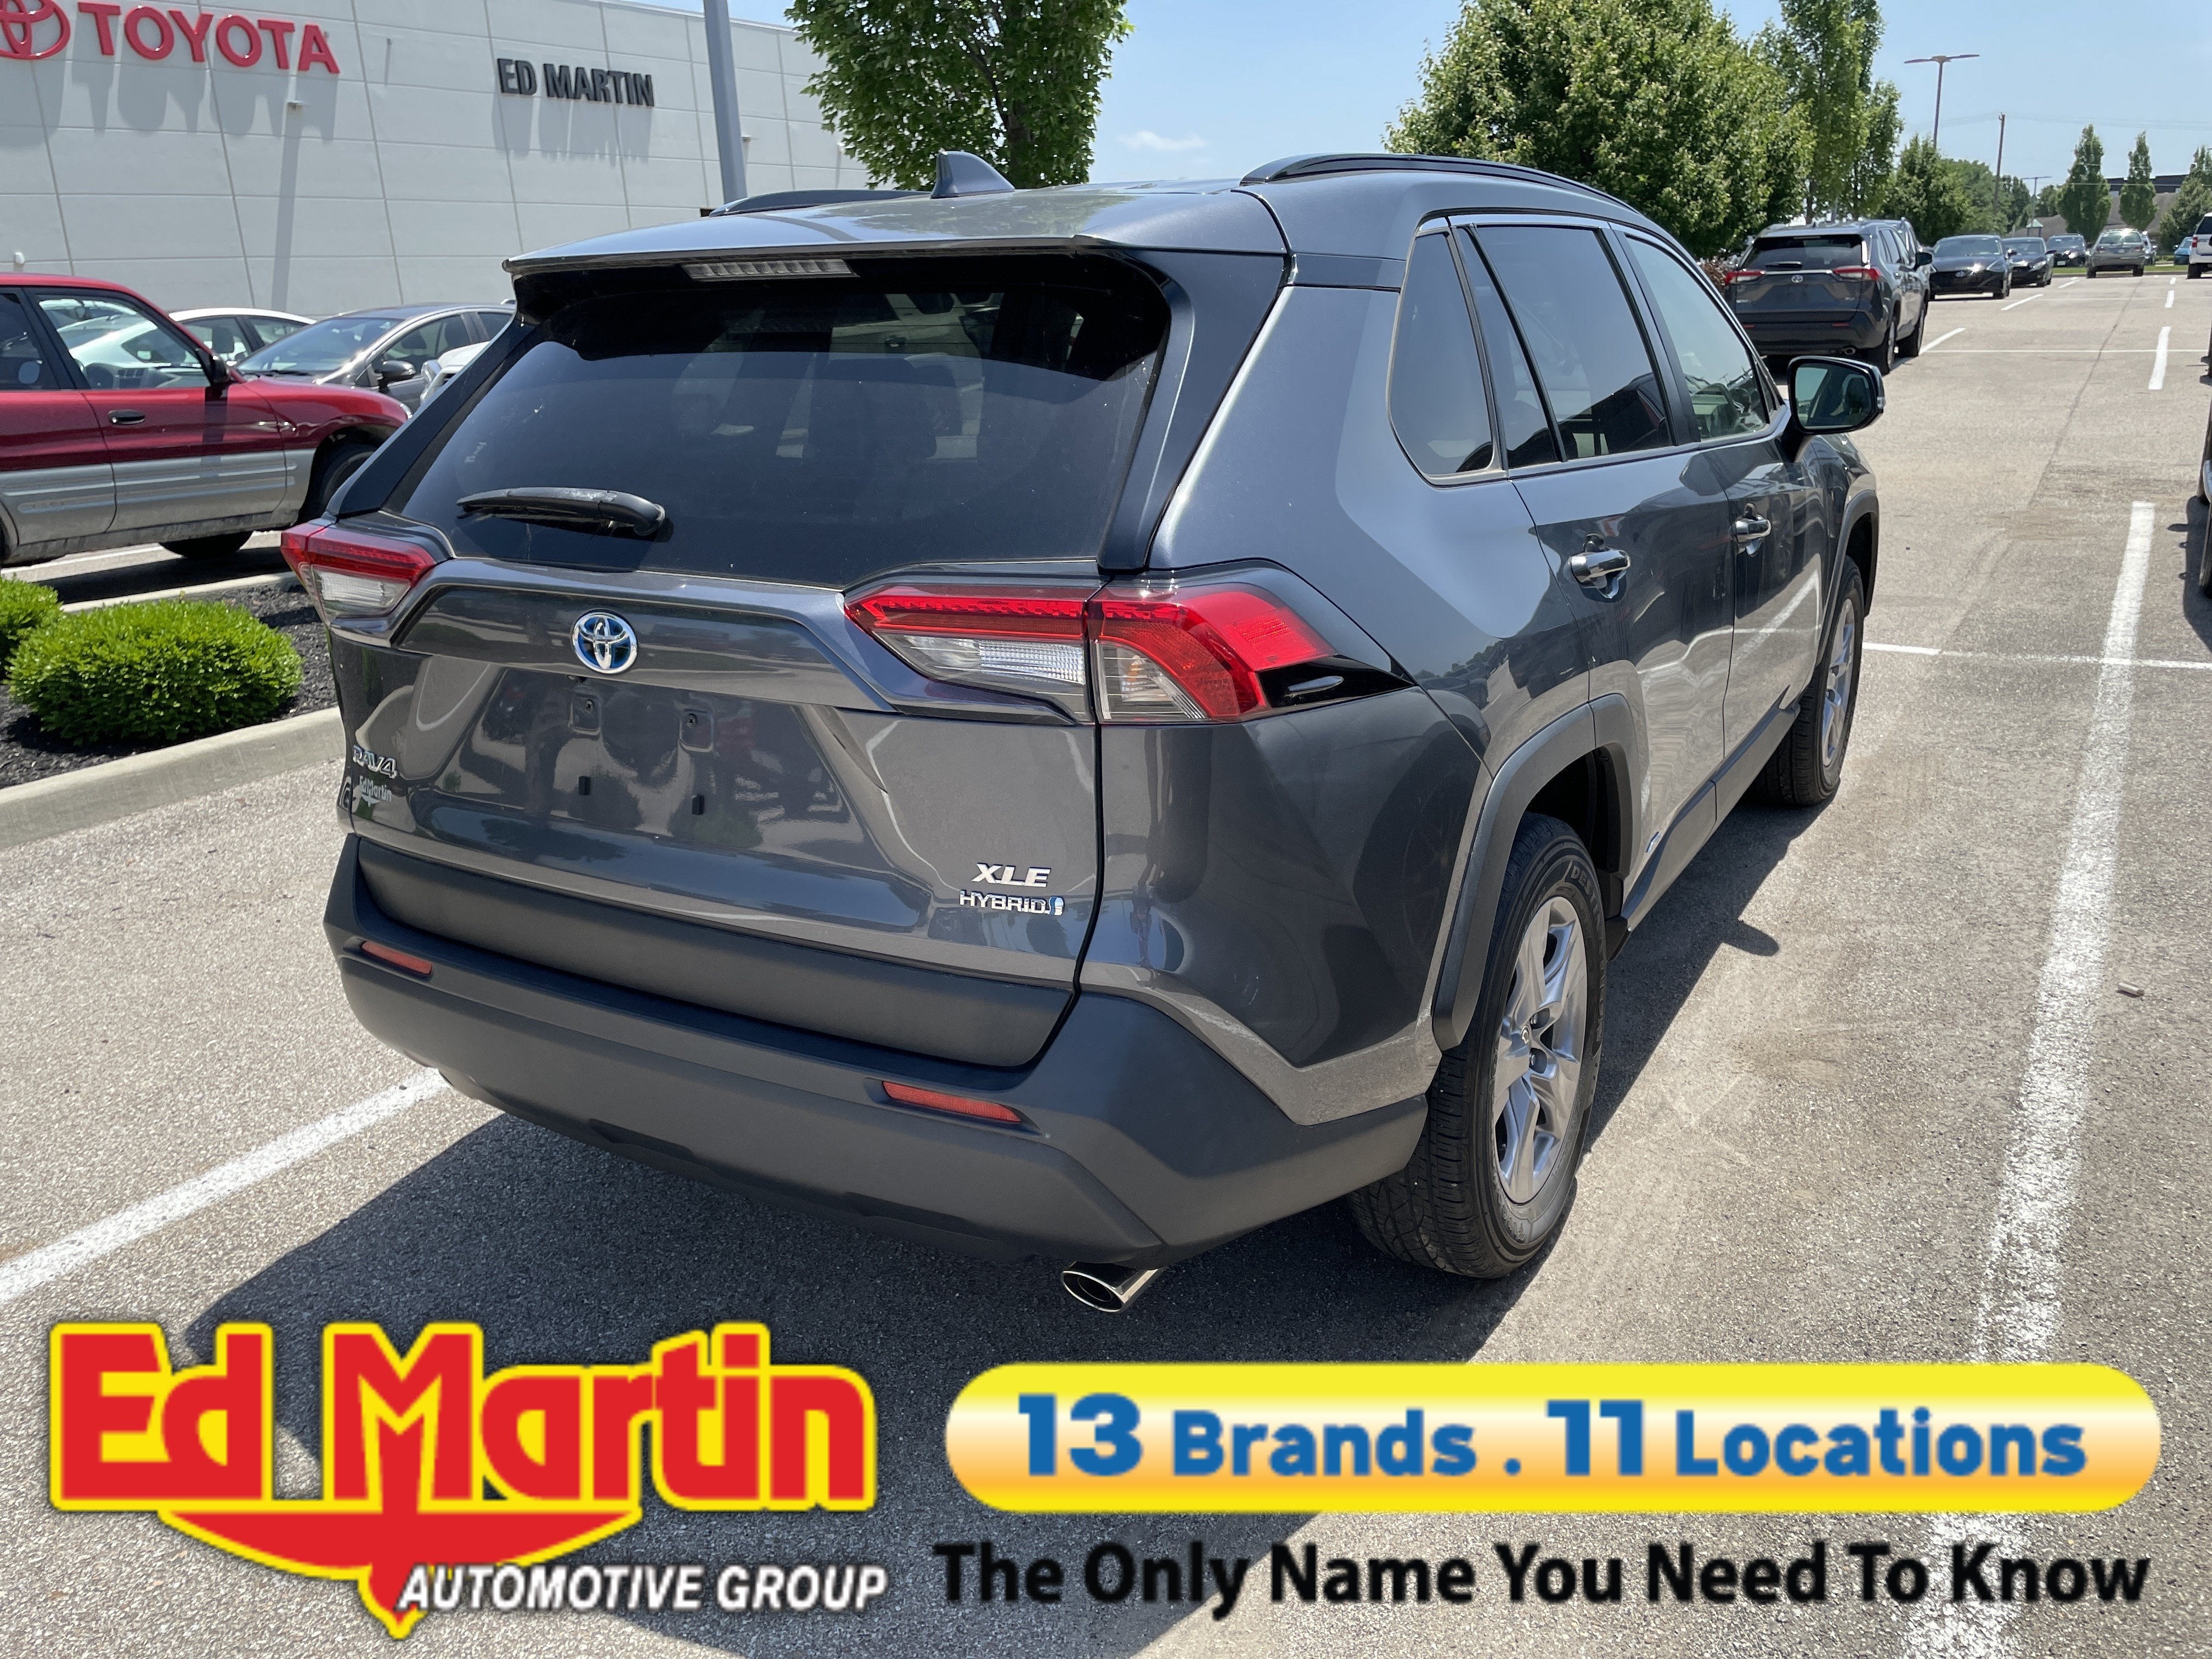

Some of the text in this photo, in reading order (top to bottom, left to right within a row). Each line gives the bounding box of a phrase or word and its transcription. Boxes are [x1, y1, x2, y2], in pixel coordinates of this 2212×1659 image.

[78, 2, 340, 74] TOYOTA
[496, 58, 655, 107] ED MARTIN
[353, 744, 398, 779] RAV4
[972, 863, 1051, 887] XLE
[960, 889, 1047, 915] HYBRID
